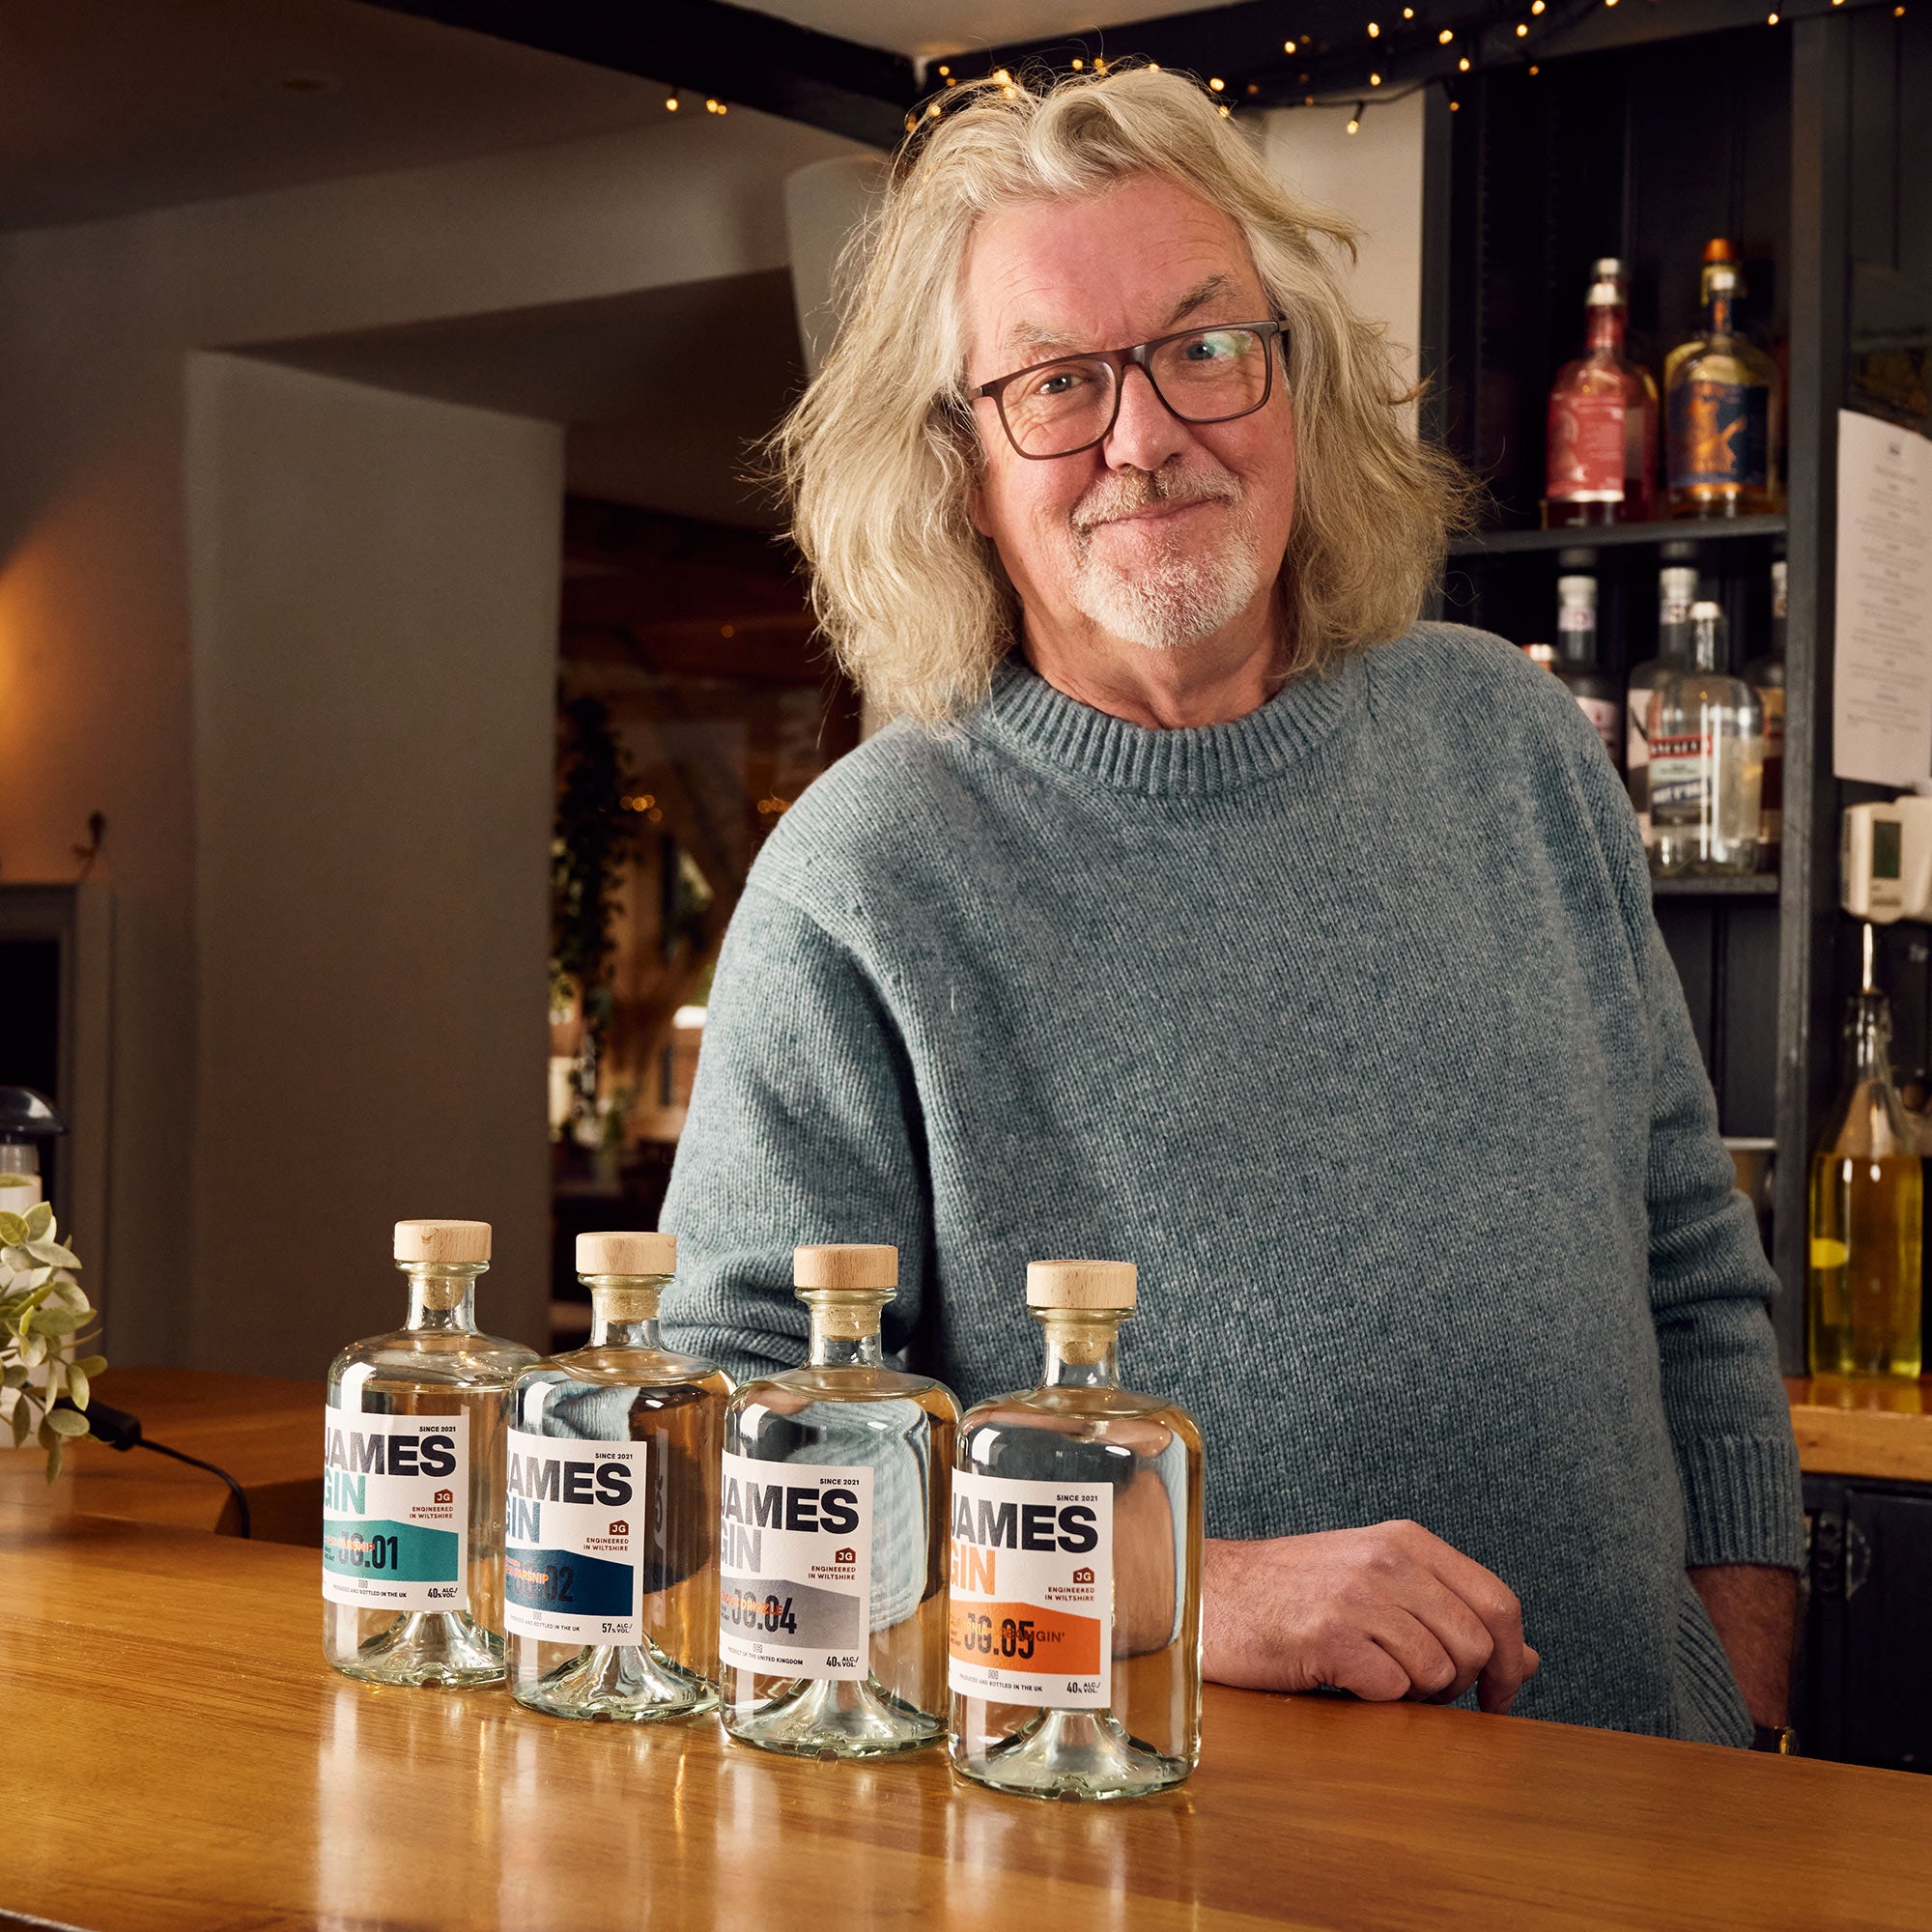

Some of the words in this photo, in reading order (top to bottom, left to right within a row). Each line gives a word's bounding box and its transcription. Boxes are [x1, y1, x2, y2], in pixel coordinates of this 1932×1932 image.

[325, 1427, 456, 1477] JAMES
[324, 1467, 365, 1515] GIN
[721, 1474, 859, 1534] JAMES
[506, 1492, 540, 1544] GIN
[611, 1524, 626, 1533] JG
[952, 1492, 1098, 1553] JAMES
[721, 1518, 761, 1573] GIN
[838, 1552, 853, 1561] JG
[951, 1539, 995, 1595] GIN
[1076, 1573, 1092, 1581] JG
[533, 1621, 554, 1630] BOTTLED
[964, 1612, 1035, 1660] JG.05
[757, 1654, 775, 1662] UNITED
[776, 1657, 803, 1665] KINGDOM
[989, 1680, 1012, 1690] BOTTLED
